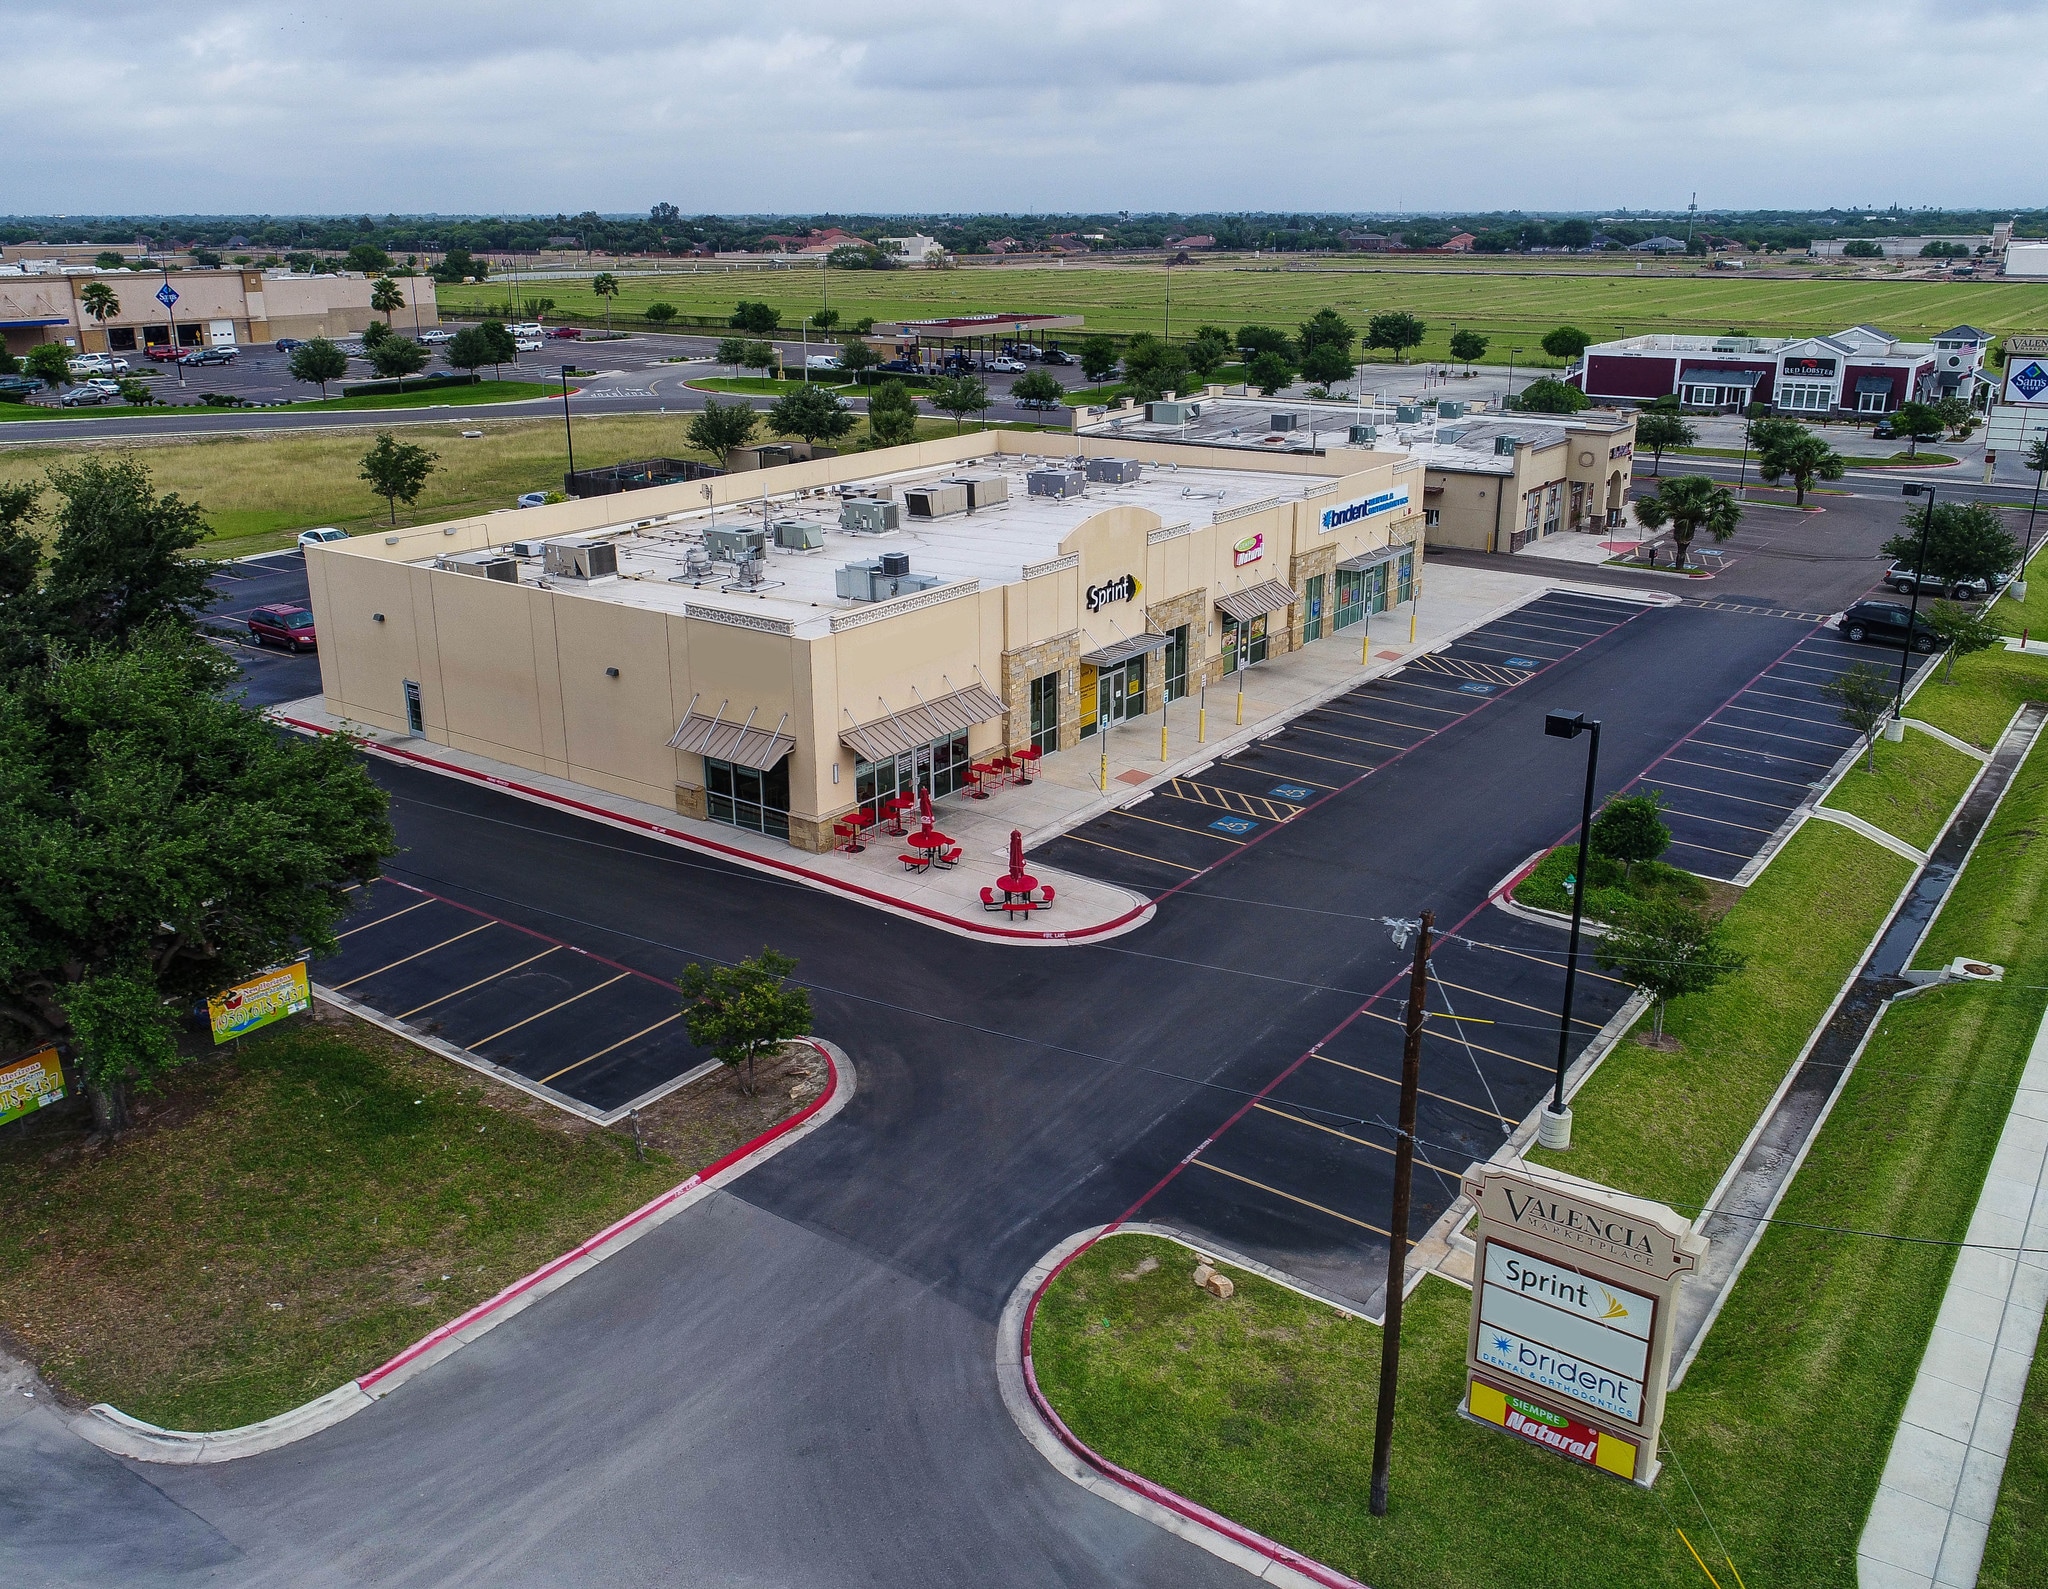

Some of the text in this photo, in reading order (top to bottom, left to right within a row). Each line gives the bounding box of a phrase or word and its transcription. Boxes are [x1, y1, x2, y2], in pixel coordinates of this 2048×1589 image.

[1801, 366, 1834, 376] LOBSTER
[2016, 374, 2047, 388] Sam's
[1088, 577, 1129, 611] Sprint
[243, 974, 292, 996] New Horizons
[216, 1006, 250, 1034] (956)
[250, 984, 305, 1017] 618-5437
[1, 1062, 41, 1083] Horizons
[13, 1069, 46, 1087] Academy
[1502, 1187, 1654, 1255] VALENCIA
[1527, 1217, 1654, 1267] MARKETPLACE
[1506, 1259, 1589, 1308] Sprint
[1483, 1353, 1634, 1418] DENTAL & ORTHODONTICS
[1519, 1343, 1629, 1404] brident
[1512, 1398, 1560, 1425] SIEMPRE
[1505, 1411, 1598, 1460] Natural
